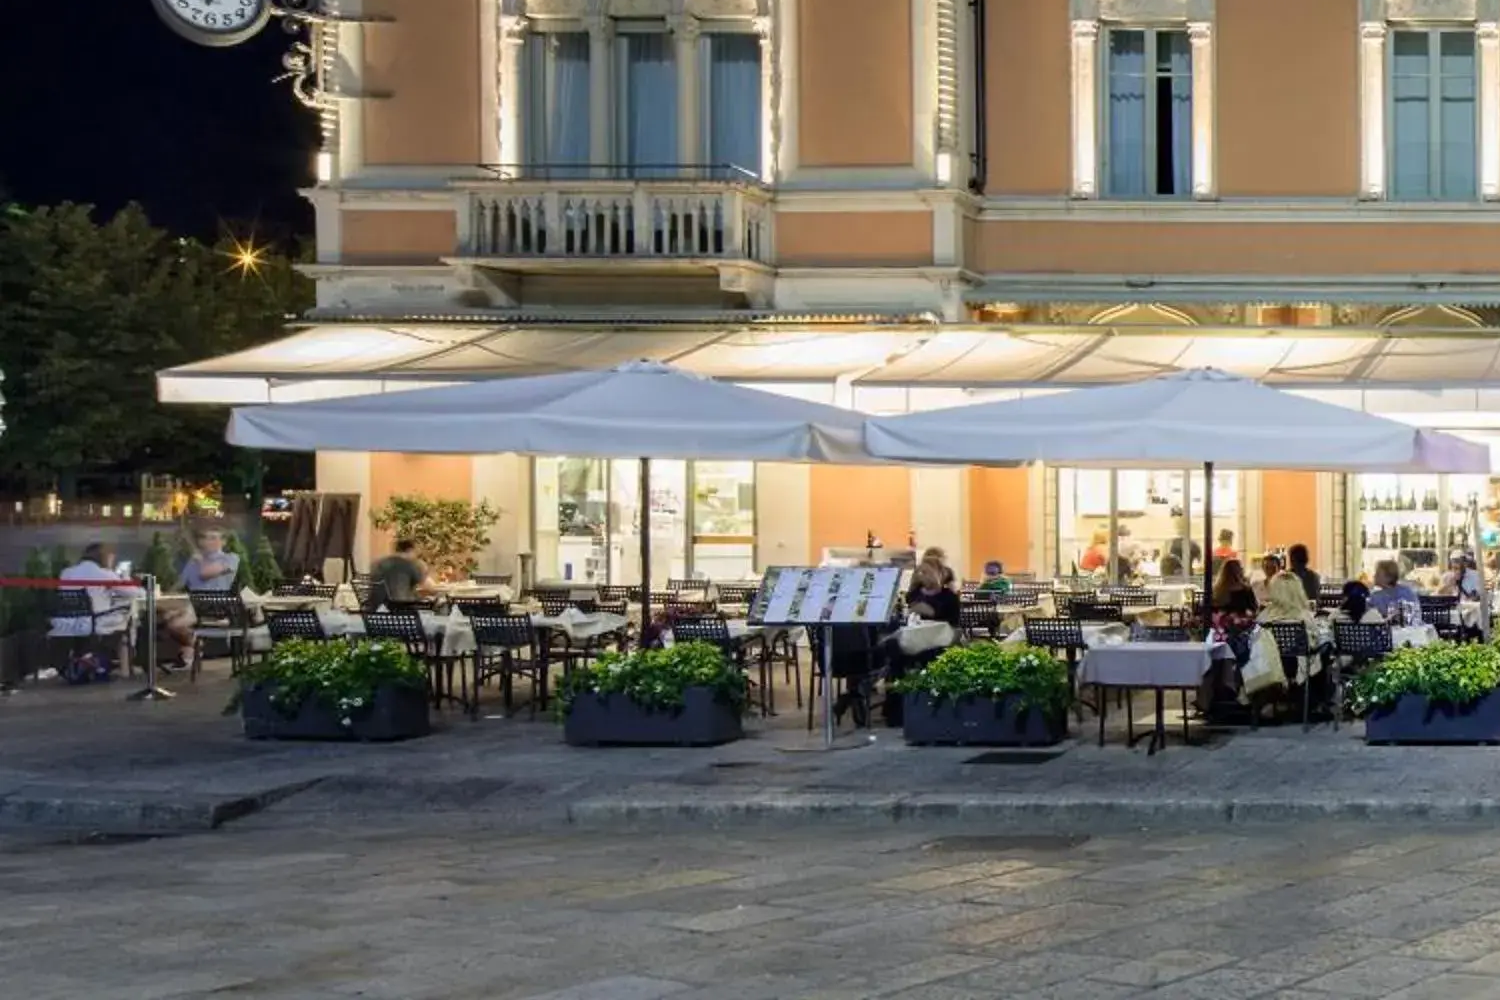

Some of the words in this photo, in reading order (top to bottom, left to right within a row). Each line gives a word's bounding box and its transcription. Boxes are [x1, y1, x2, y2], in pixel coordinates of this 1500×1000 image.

[192, 7, 203, 20] 7
[204, 12, 217, 24] 6
[235, 7, 245, 18] 4
[222, 13, 233, 26] 5
